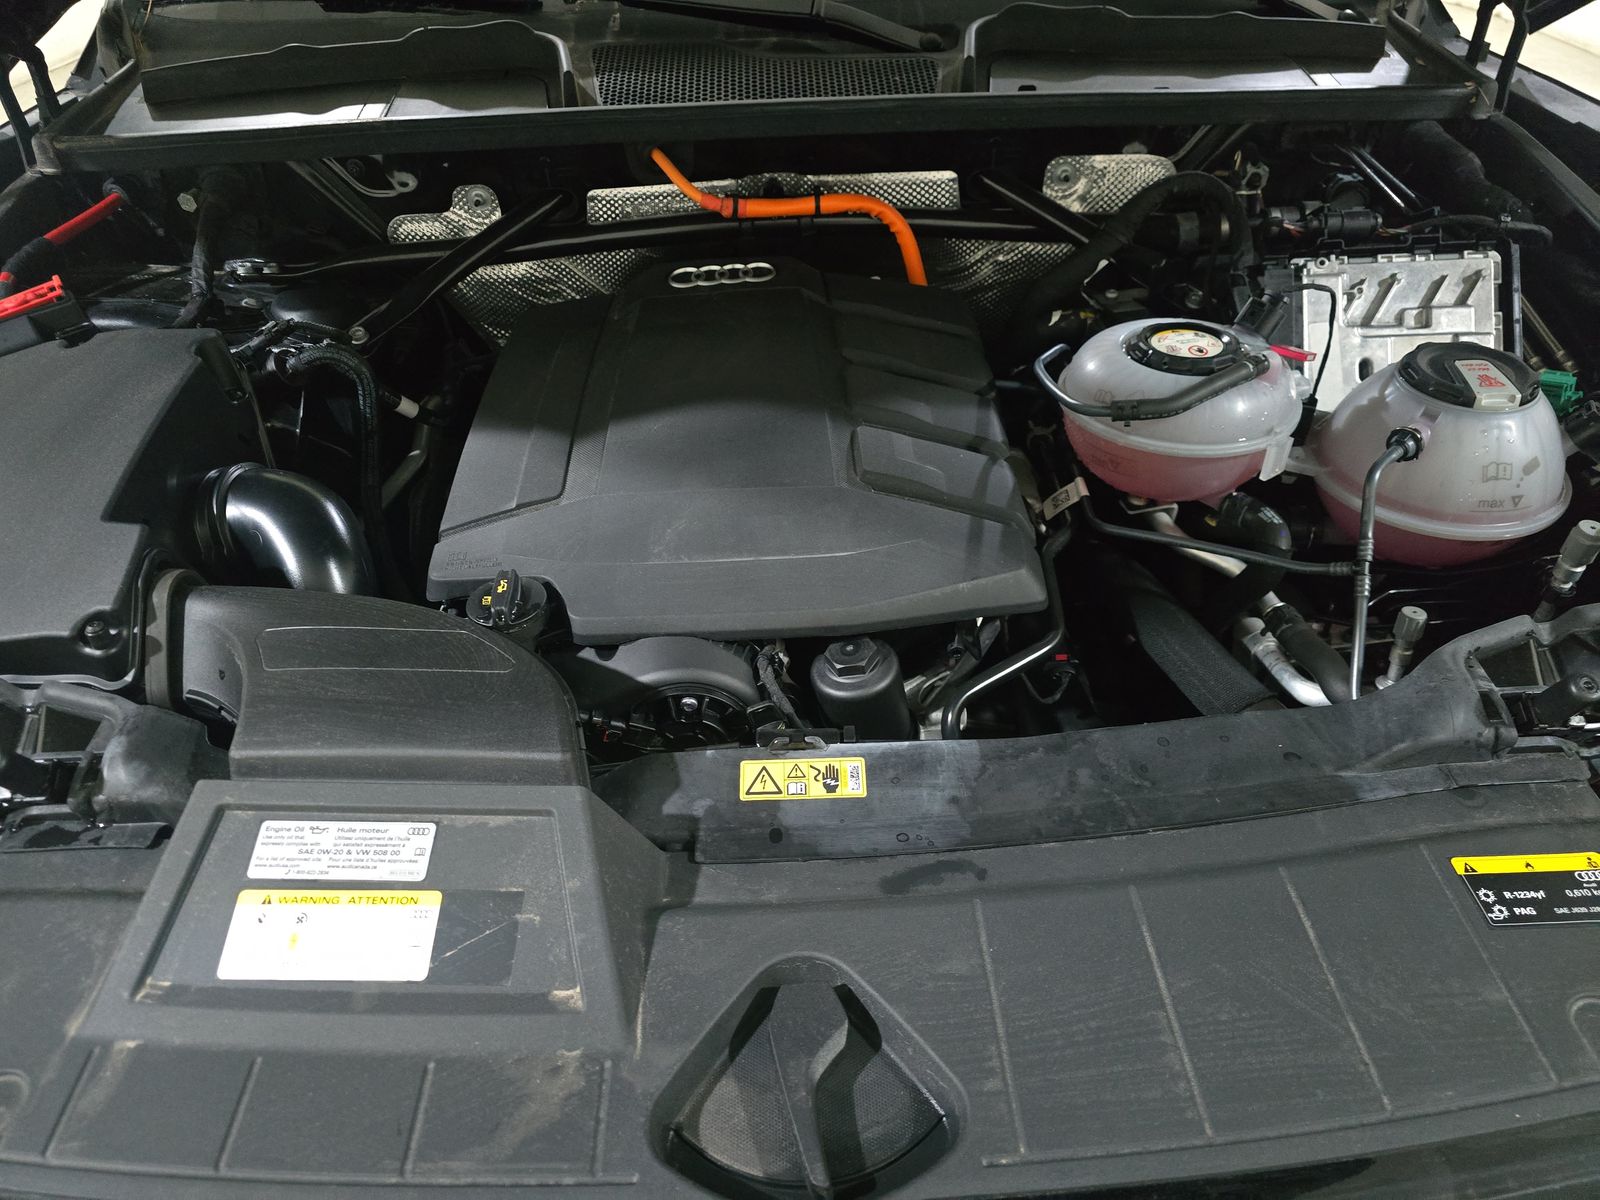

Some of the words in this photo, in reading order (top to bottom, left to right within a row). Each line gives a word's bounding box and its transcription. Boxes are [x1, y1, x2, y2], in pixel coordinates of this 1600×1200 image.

[1478, 499, 1505, 508] max
[1503, 890, 1546, 900] R-1234yf
[1565, 888, 1592, 898] 0,610
[278, 896, 340, 905] WARNING
[348, 896, 419, 905] ATTENTION
[1513, 907, 1537, 915] PAG
